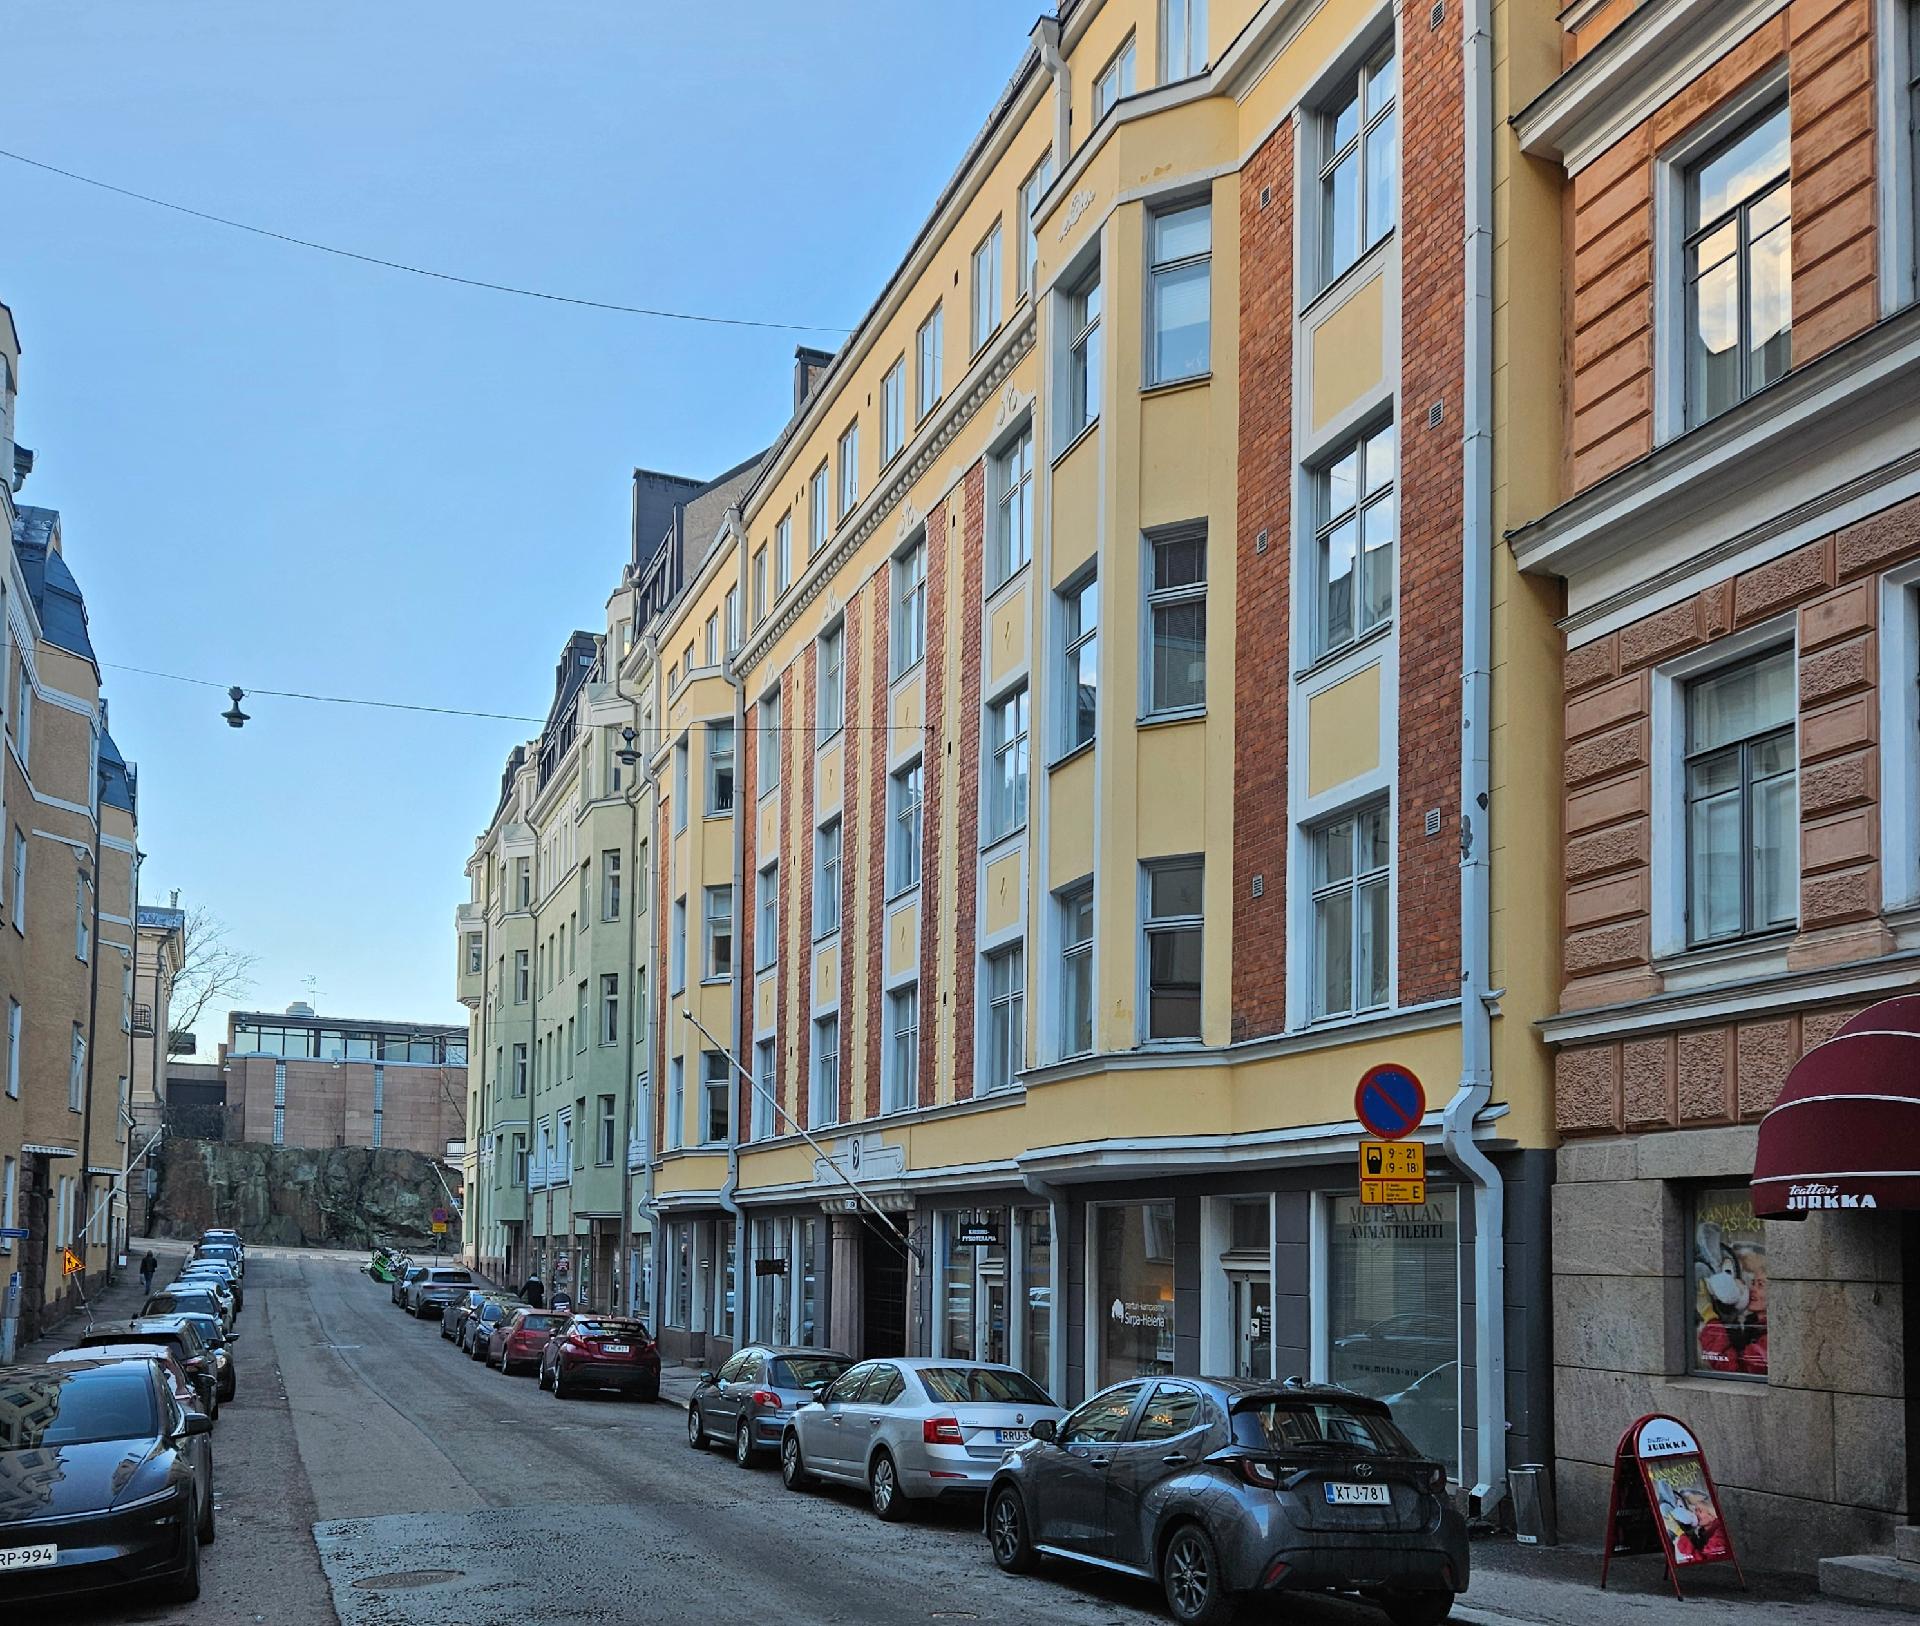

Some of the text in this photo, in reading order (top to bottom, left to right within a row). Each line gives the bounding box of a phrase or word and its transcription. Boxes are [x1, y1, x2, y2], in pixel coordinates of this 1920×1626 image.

[853, 1141, 859, 1168] 9
[1388, 1148, 1395, 1159] 9
[1406, 1148, 1416, 1159] 21
[1385, 1163, 1395, 1173] (9
[1406, 1163, 1419, 1173] 18)
[1413, 1186, 1420, 1199] E
[1789, 1183, 1839, 1195] teatteri
[1787, 1194, 1877, 1209] JURKKA
[1349, 1224, 1443, 1239] AMMATTILEHTI
[1124, 1312, 1165, 1327] Sirpa-Helena
[1002, 1431, 1029, 1441] RRU-3
[1647, 1440, 1687, 1451] JURKKA
[1335, 1486, 1384, 1501] XTJ-781
